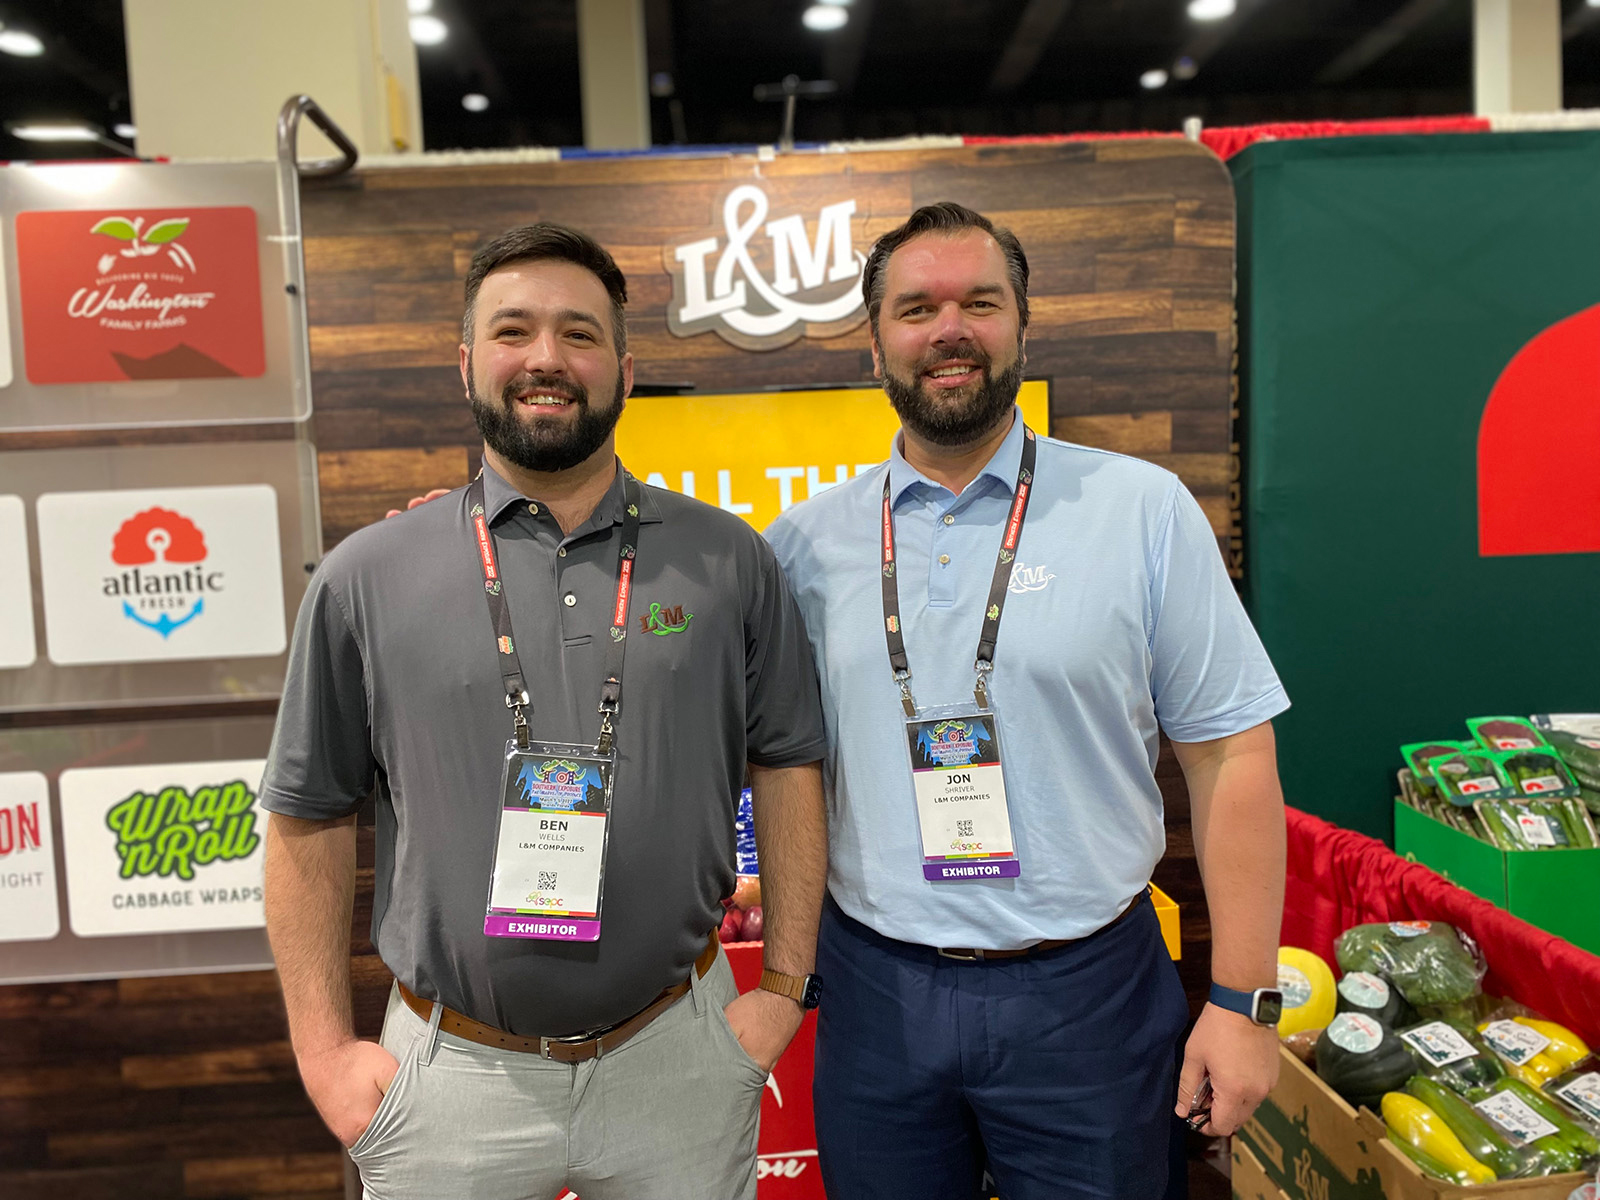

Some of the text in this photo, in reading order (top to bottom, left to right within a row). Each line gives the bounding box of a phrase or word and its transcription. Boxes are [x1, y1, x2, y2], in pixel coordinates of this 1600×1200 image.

[674, 185, 868, 336] L&M
[68, 282, 215, 320] Washington
[99, 314, 187, 331] FAMILY FARMS
[765, 464, 881, 512] TH
[103, 566, 224, 597] atlantic
[140, 597, 186, 609] FRESH
[639, 602, 694, 636] L&M
[946, 773, 971, 785] JON
[944, 785, 976, 794] SHRIVER
[950, 793, 991, 802] COMPANIES
[106, 779, 257, 843] Wrap
[540, 819, 568, 831] BEN
[539, 833, 566, 841] WELLS
[538, 843, 585, 852] COMPANIES
[942, 866, 1000, 877] EXHIBITOR
[112, 886, 263, 909] CABBAGE WRAPS
[508, 922, 577, 936] EXHIBITOR
